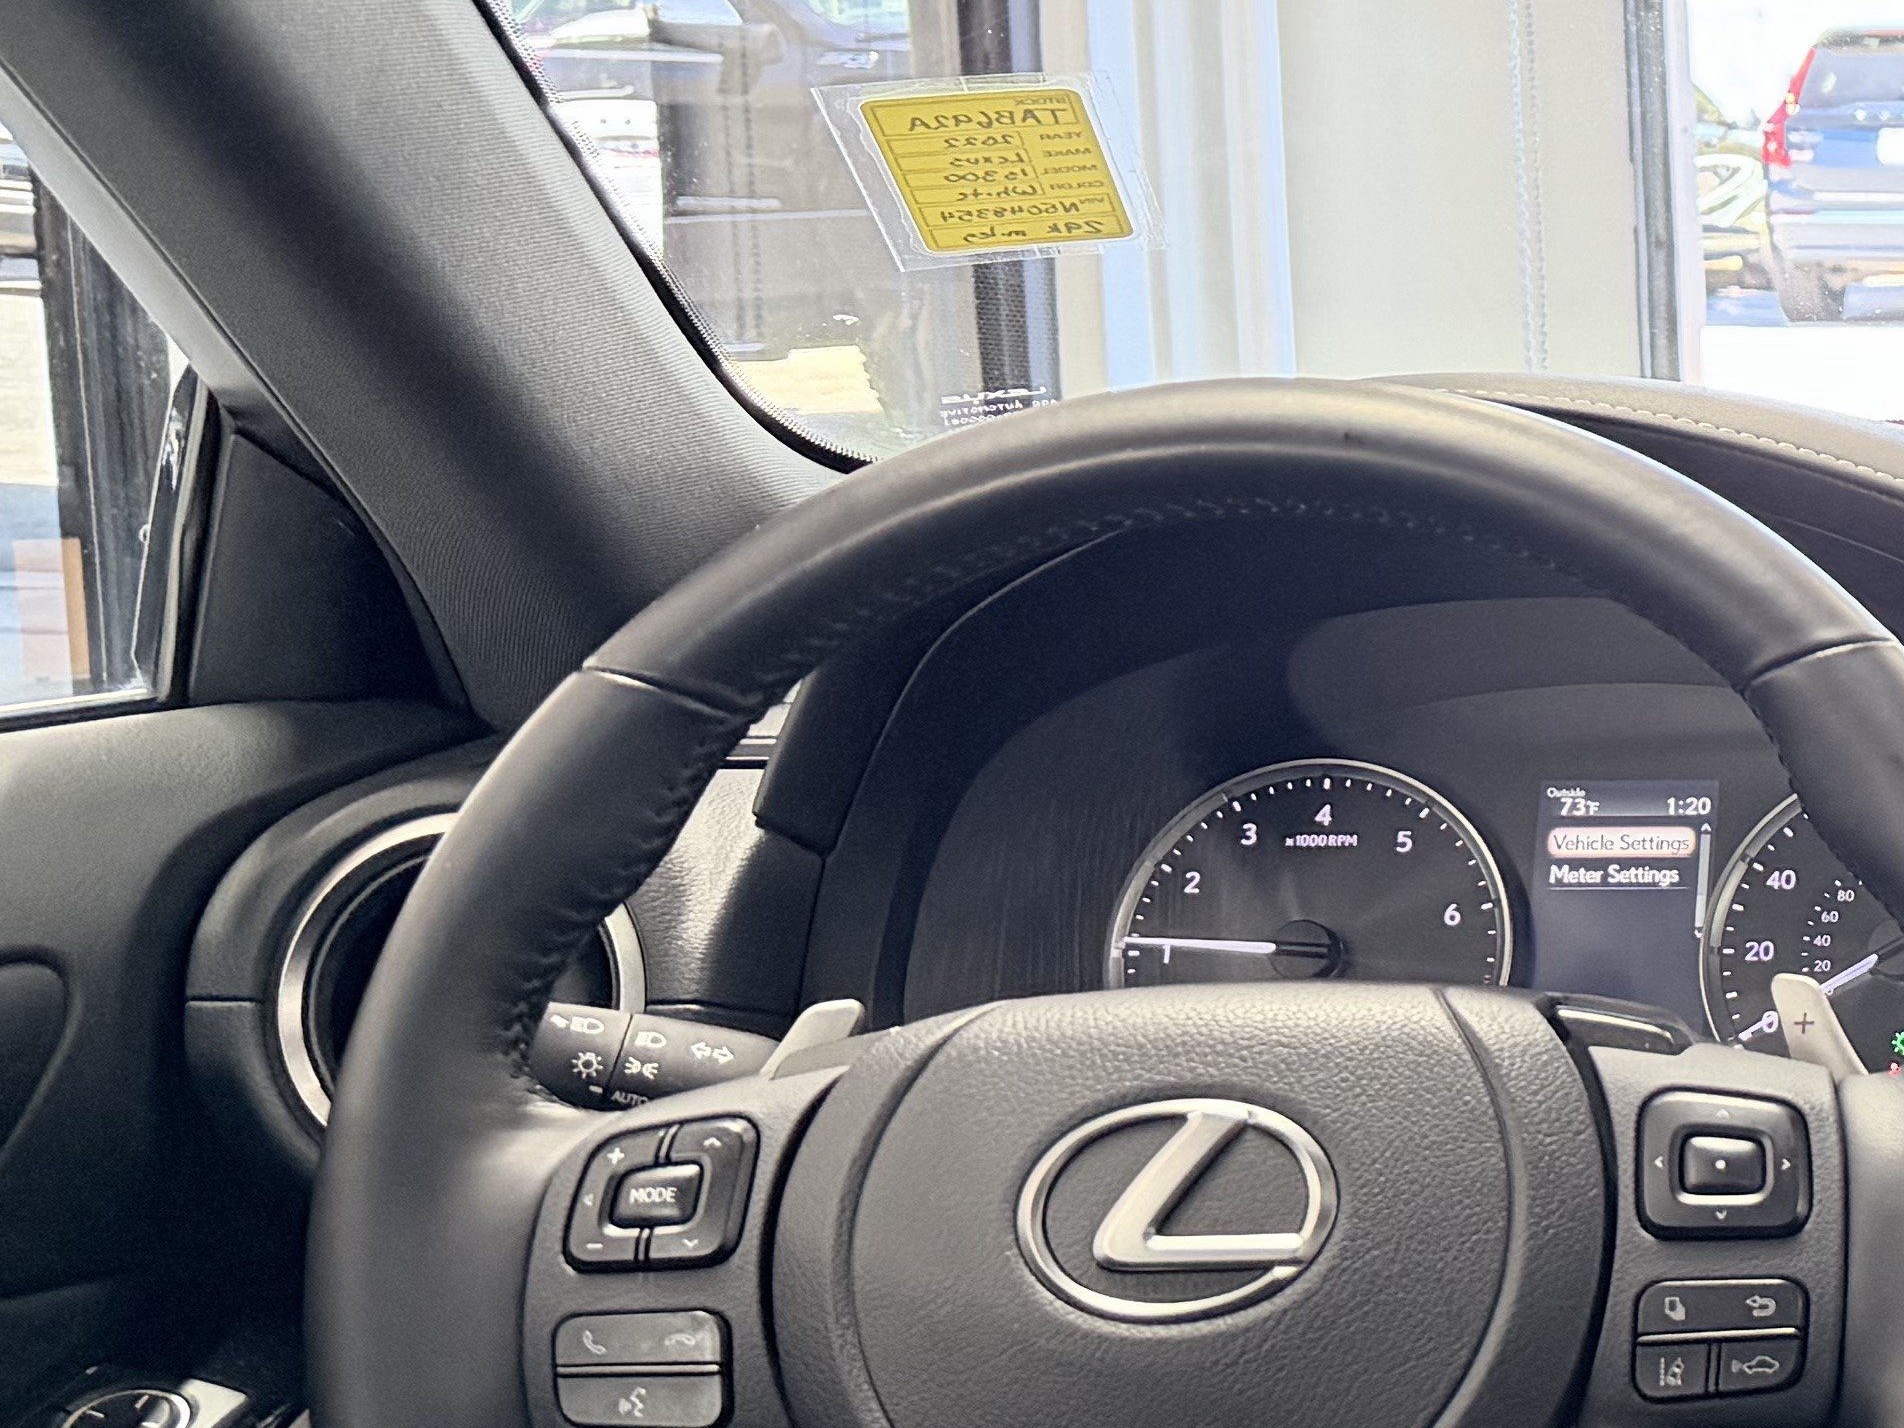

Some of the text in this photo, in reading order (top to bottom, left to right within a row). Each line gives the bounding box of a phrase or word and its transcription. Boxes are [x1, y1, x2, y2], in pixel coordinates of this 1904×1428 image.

[1547, 787, 1586, 798] Outside
[1314, 804, 1332, 826] 4
[1667, 797, 1712, 815] 1:20
[1241, 823, 1258, 846] 3
[1396, 830, 1413, 853] 5
[1553, 834, 1690, 854] Vehicle Settings
[1184, 871, 1201, 895] 2
[1549, 864, 1680, 886] Meter Settings
[1766, 870, 1797, 890] 40
[1837, 889, 1855, 902] 80
[1443, 903, 1462, 926] 6
[1821, 910, 1839, 923] 60
[1744, 940, 1775, 962] 20
[1813, 934, 1831, 948] 40
[1813, 959, 1831, 972] 20
[629, 1187, 678, 1203] MODE
